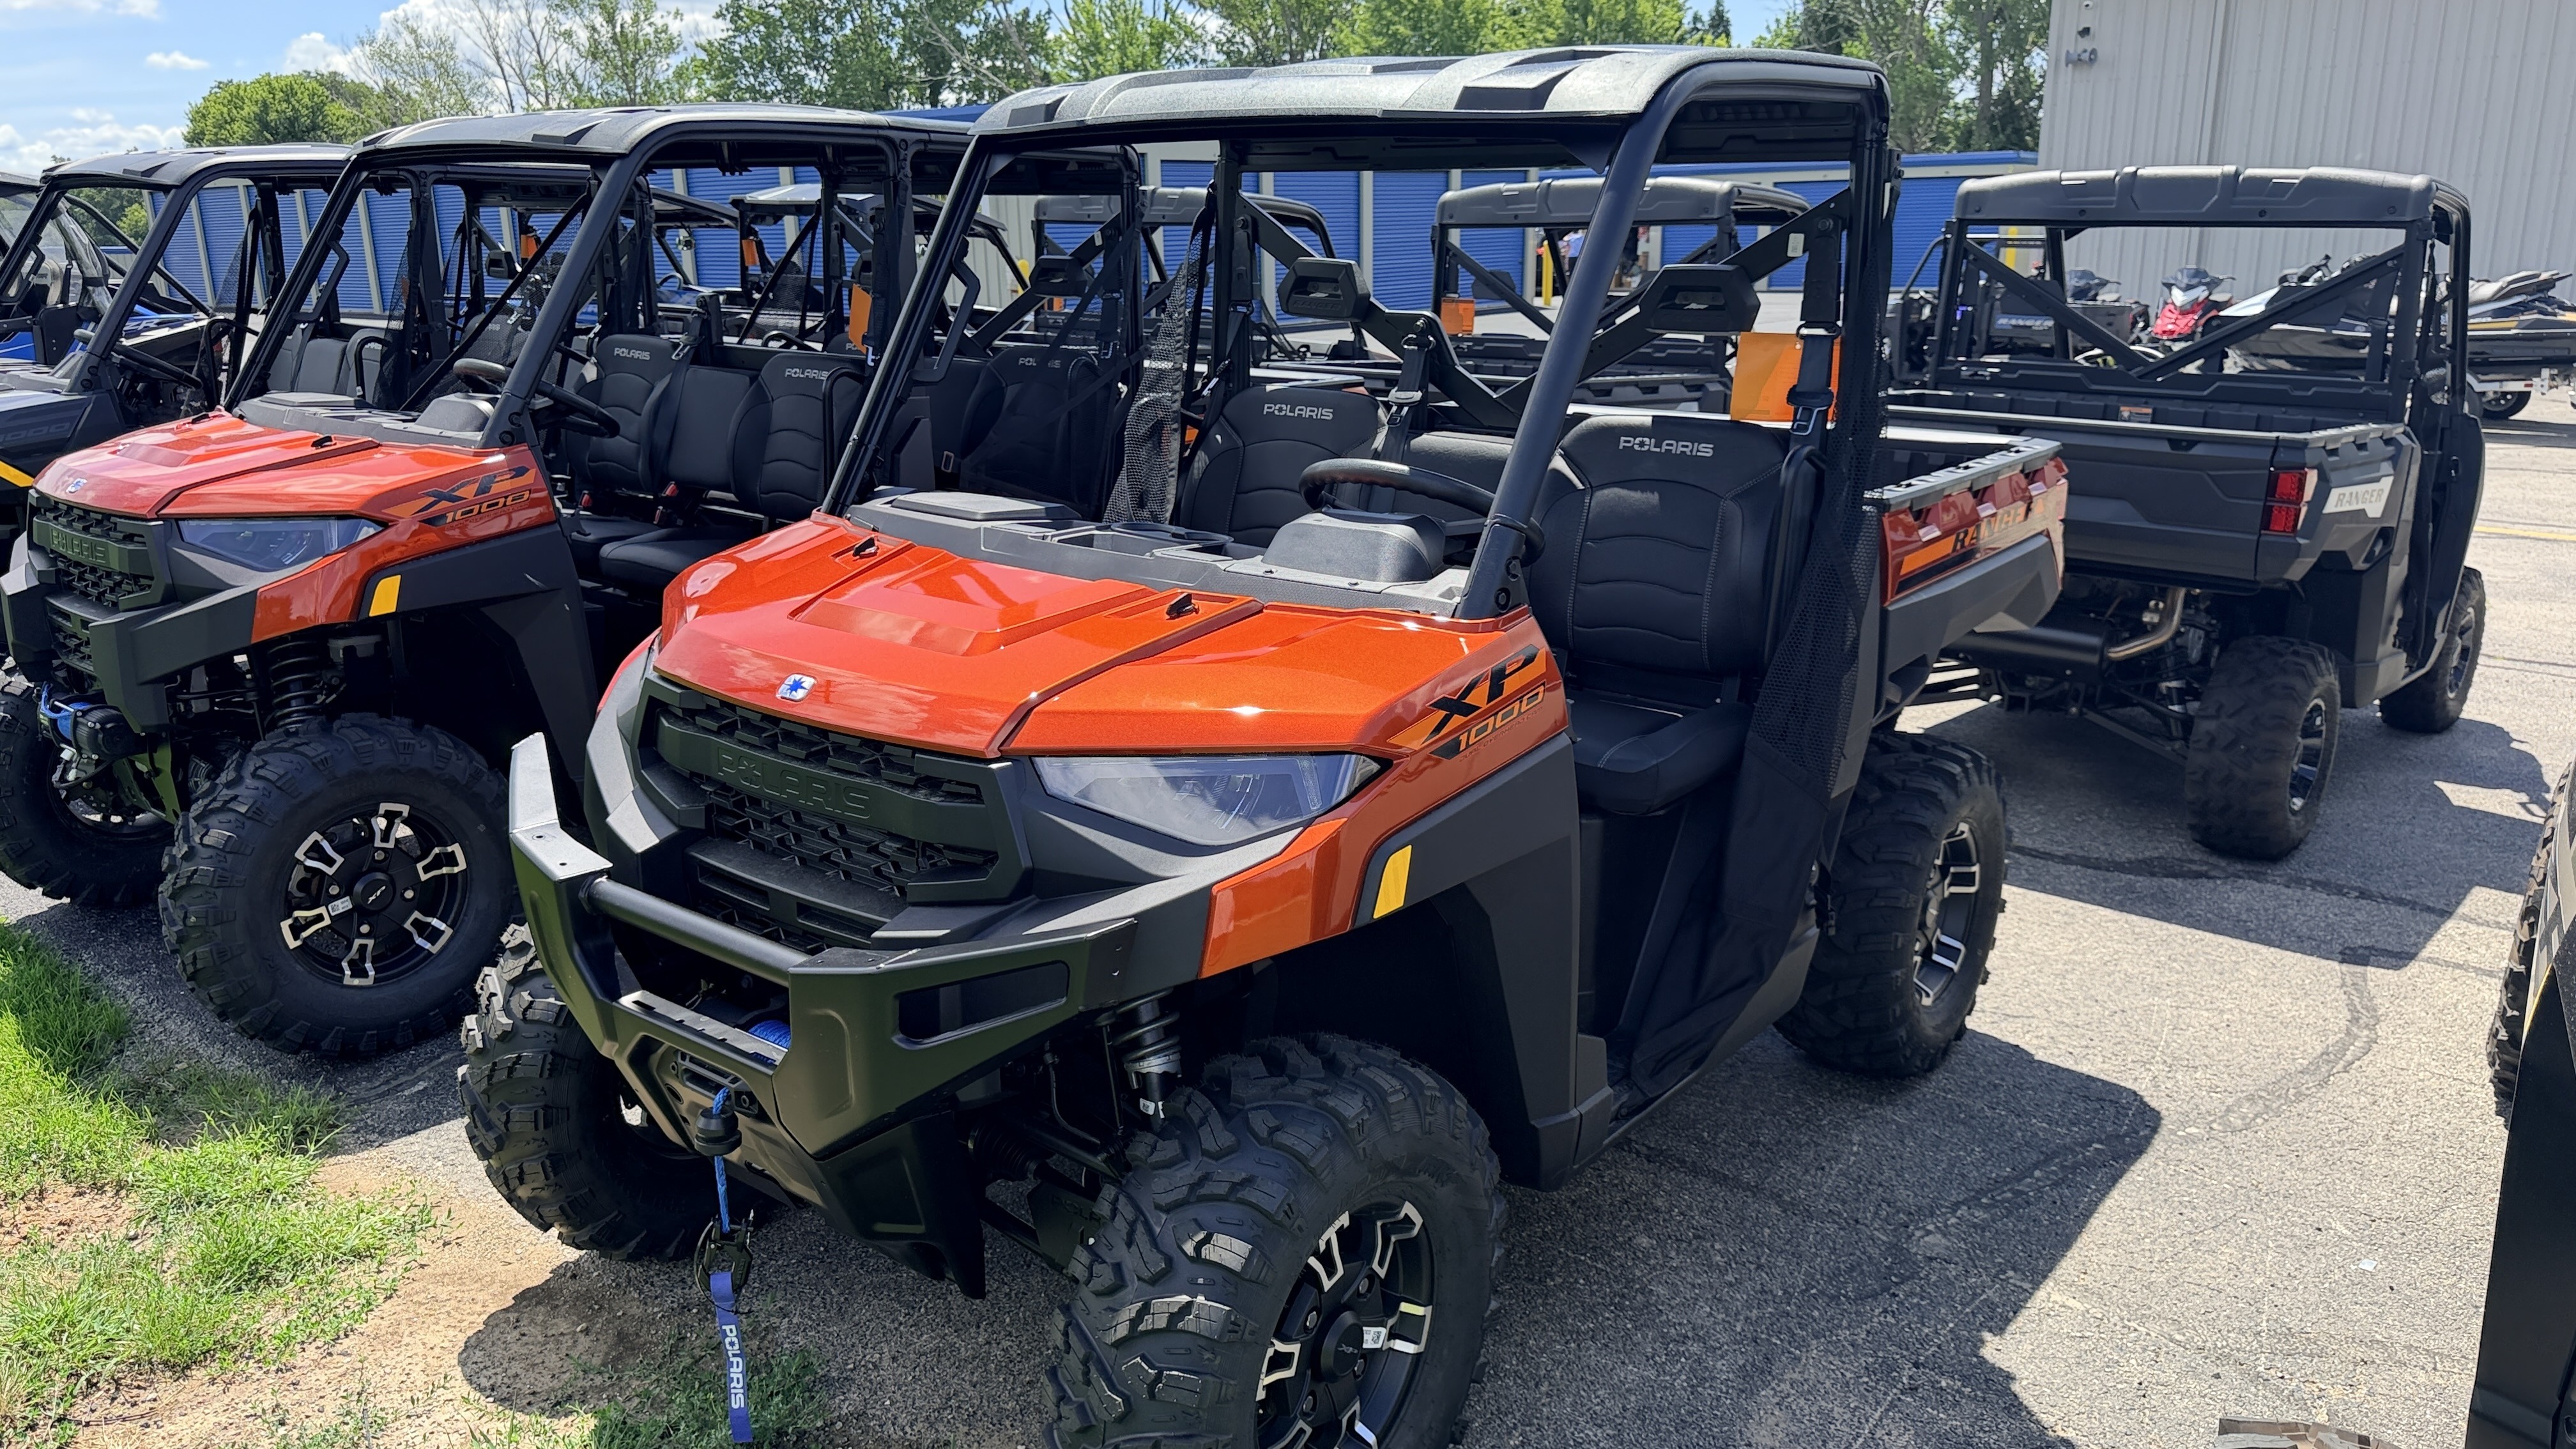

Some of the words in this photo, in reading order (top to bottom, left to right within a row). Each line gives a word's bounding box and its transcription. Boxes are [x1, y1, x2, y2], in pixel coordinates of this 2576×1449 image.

[614, 347, 651, 360] POLARIS
[785, 368, 830, 380] POLARIS
[1263, 403, 1333, 420] POLARIS
[1618, 436, 1714, 457] POLARIS
[410, 465, 531, 516] XP
[2334, 488, 2384, 508] RANGER
[445, 491, 530, 523] 1000
[1419, 644, 1540, 746] XP
[1459, 685, 1544, 752] 1000
[717, 747, 871, 819] POLARIS
[722, 1324, 745, 1409] POLARIS
